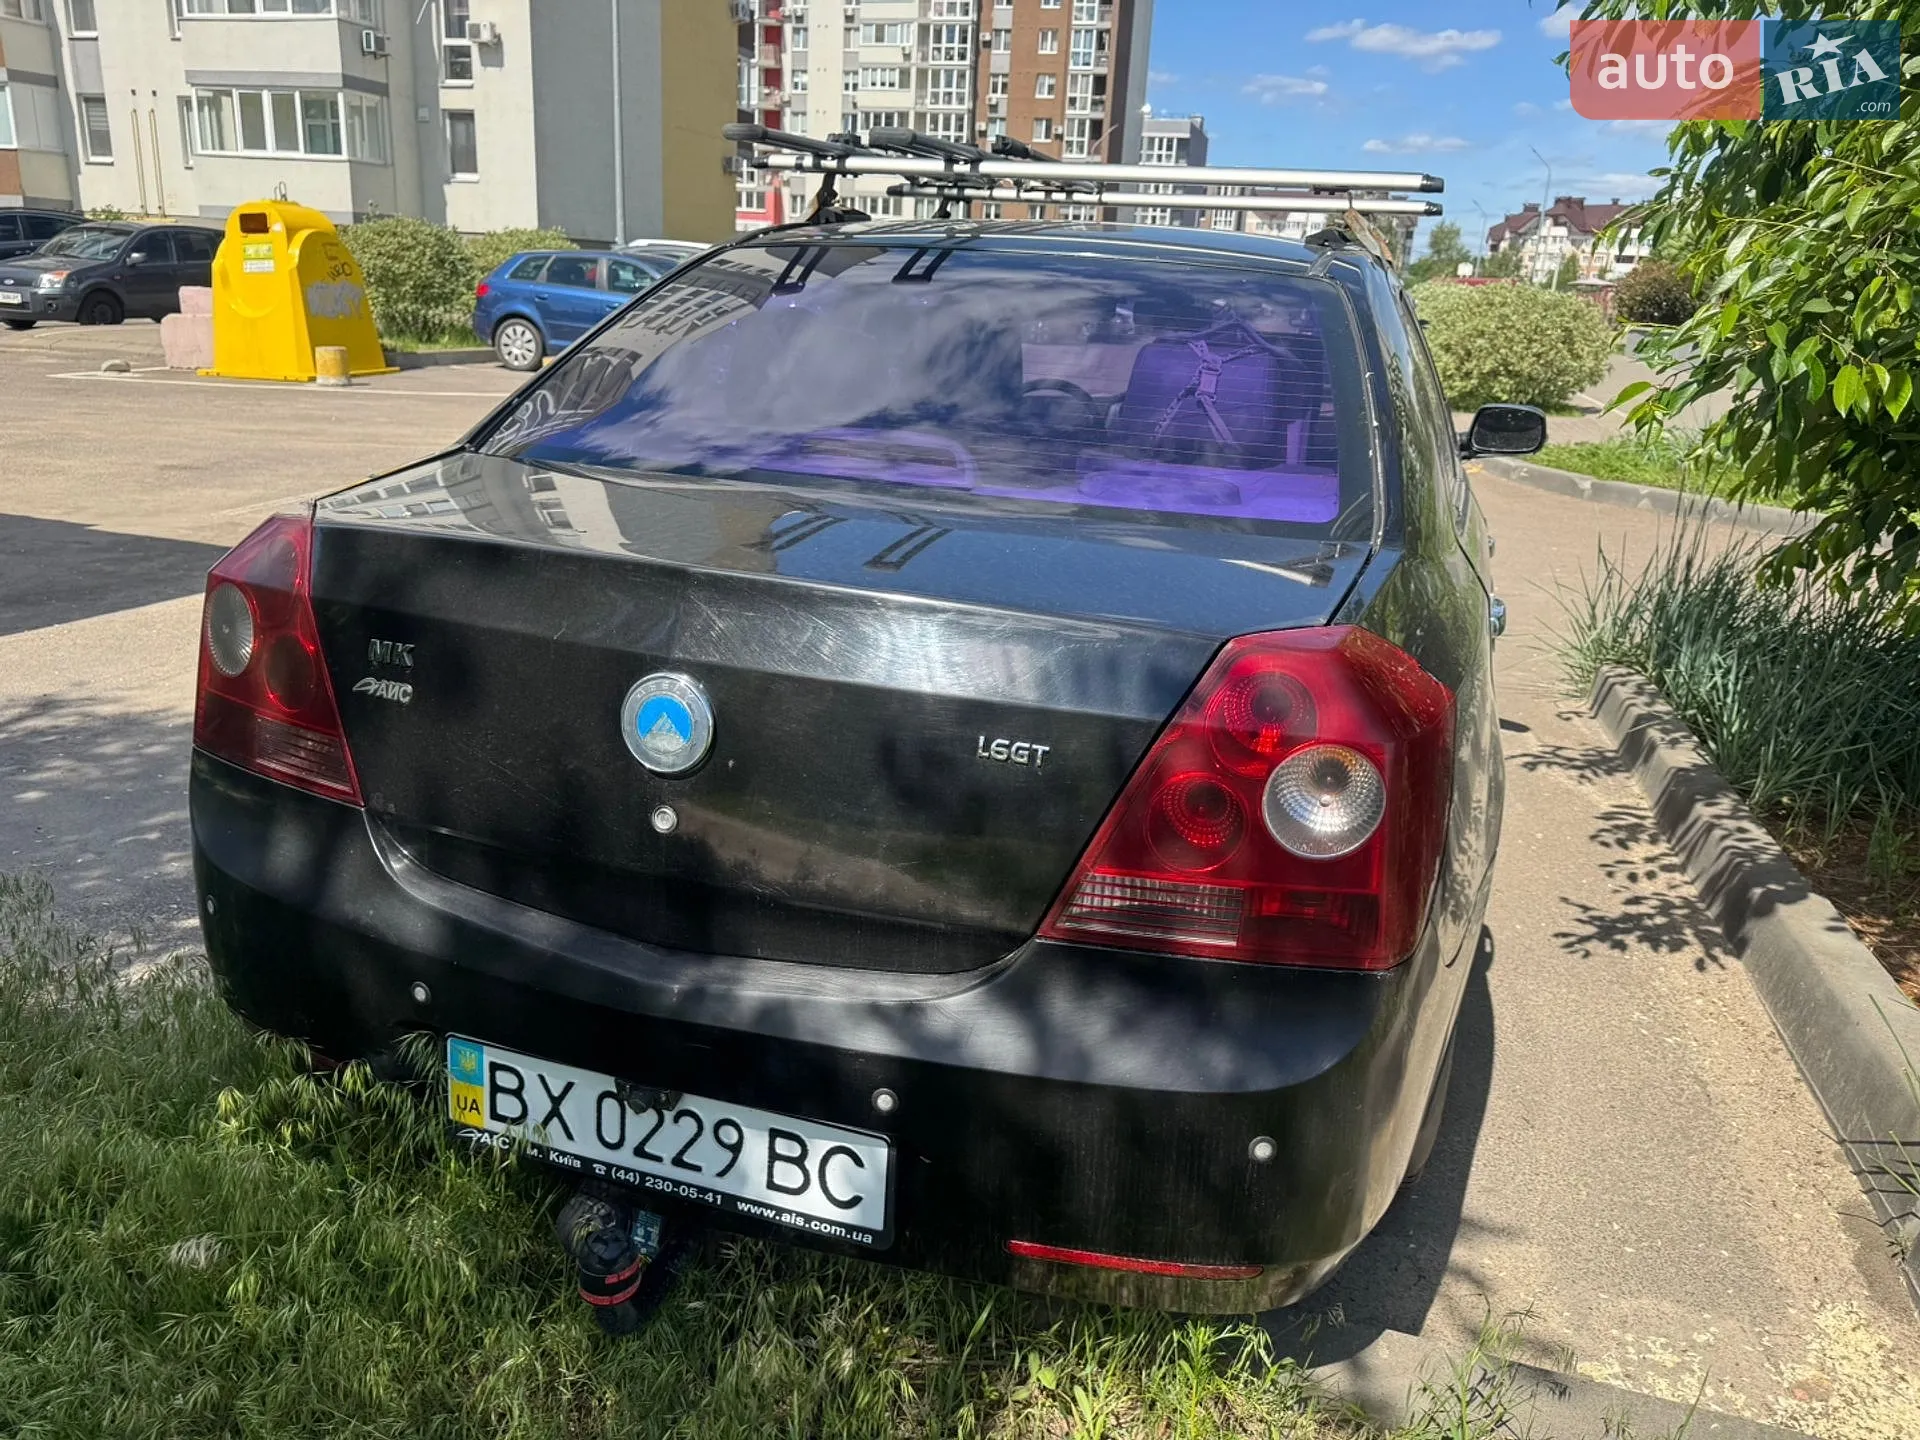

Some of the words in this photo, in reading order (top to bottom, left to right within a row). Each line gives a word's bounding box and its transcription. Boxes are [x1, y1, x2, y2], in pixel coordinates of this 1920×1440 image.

[368, 638, 415, 666] MK
[457, 1094, 481, 1115] UA
[489, 1061, 576, 1142] BX
[595, 1090, 744, 1178] 0229
[766, 1126, 866, 1210] BC
[550, 1150, 582, 1169] Київ
[611, 1169, 640, 1186] (44)
[645, 1176, 723, 1205] 230-05-41
[737, 1199, 873, 1245] www.ais.com.ua
